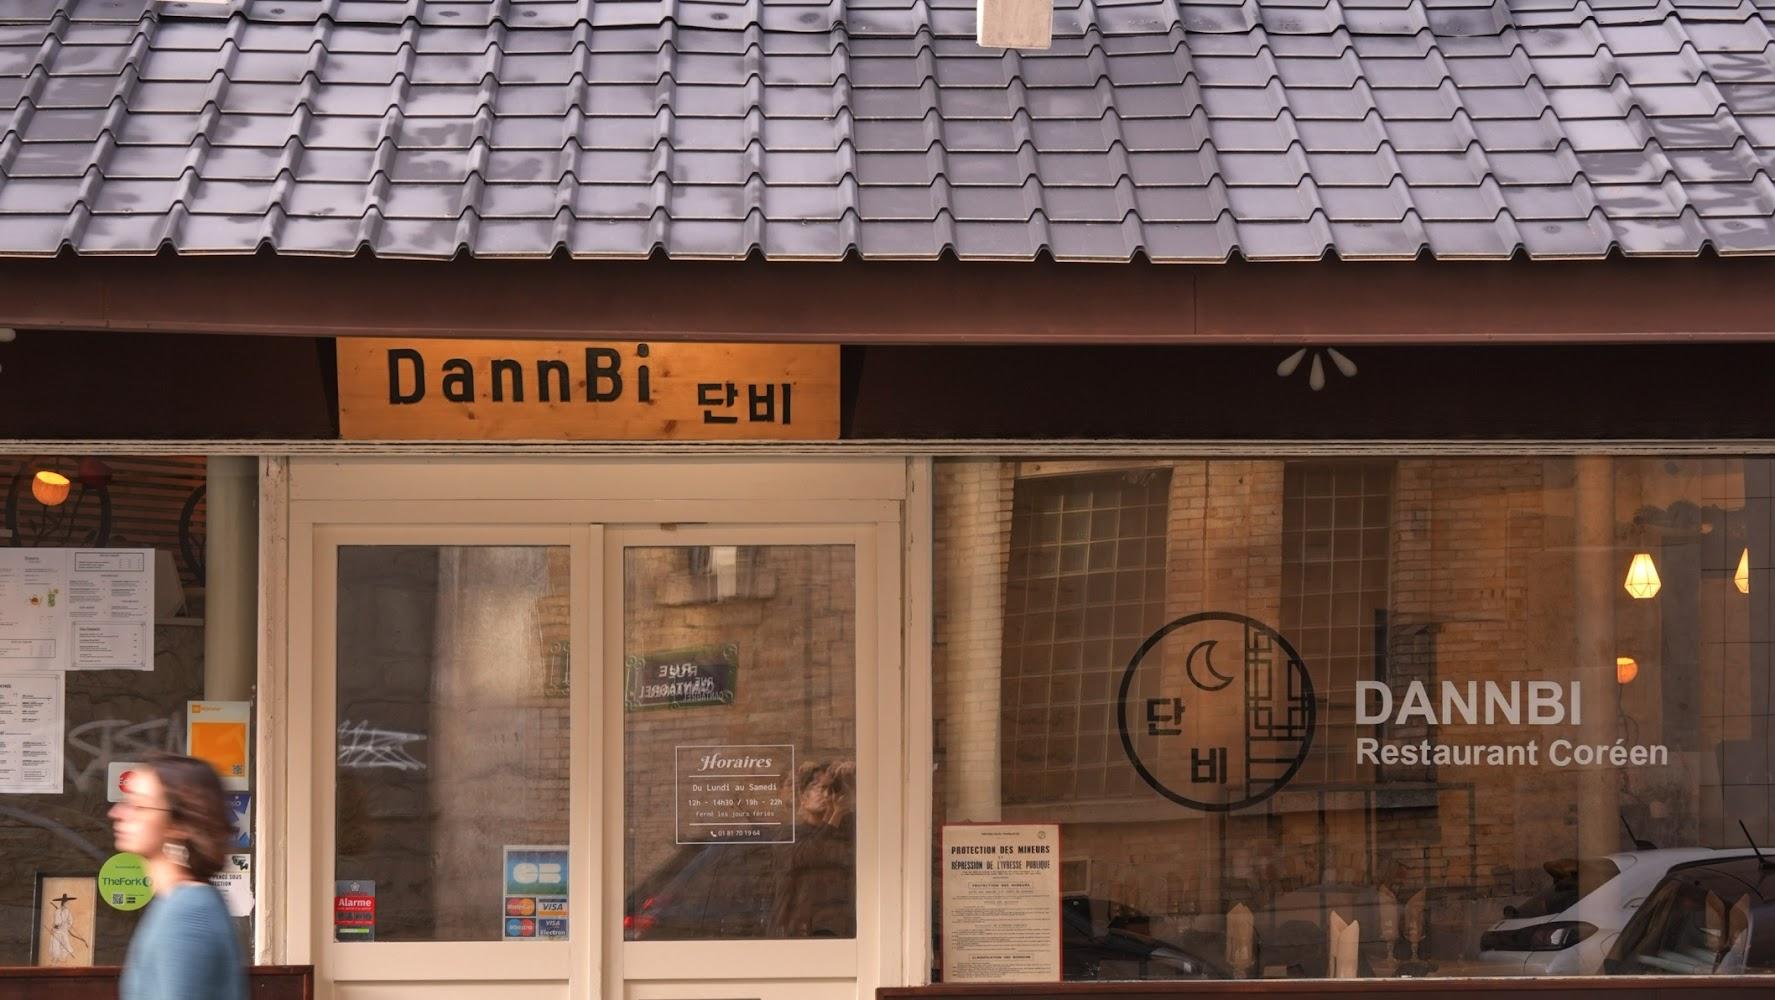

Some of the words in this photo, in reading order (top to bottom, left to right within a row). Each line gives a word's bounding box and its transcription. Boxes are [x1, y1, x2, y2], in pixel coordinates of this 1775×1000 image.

[389, 343, 651, 405] DannBi
[697, 383, 791, 424] 단비
[1355, 681, 1582, 725] DANNBI
[1147, 697, 1185, 736] 단
[698, 753, 773, 771] Horaires
[1357, 737, 1539, 766] Restaurant
[1549, 737, 1668, 766] Coréen
[1191, 747, 1227, 784] 비
[706, 783, 730, 791] Lundi
[749, 783, 777, 791] Samedi
[951, 846, 996, 854] PROTECTION
[1000, 846, 1014, 854] DES
[1018, 845, 1050, 854] MINEURS
[986, 861, 993, 869] DE
[1026, 860, 1050, 870] PUBLIQUE
[102, 877, 142, 885] TheFork
[338, 898, 372, 906] Alarme
